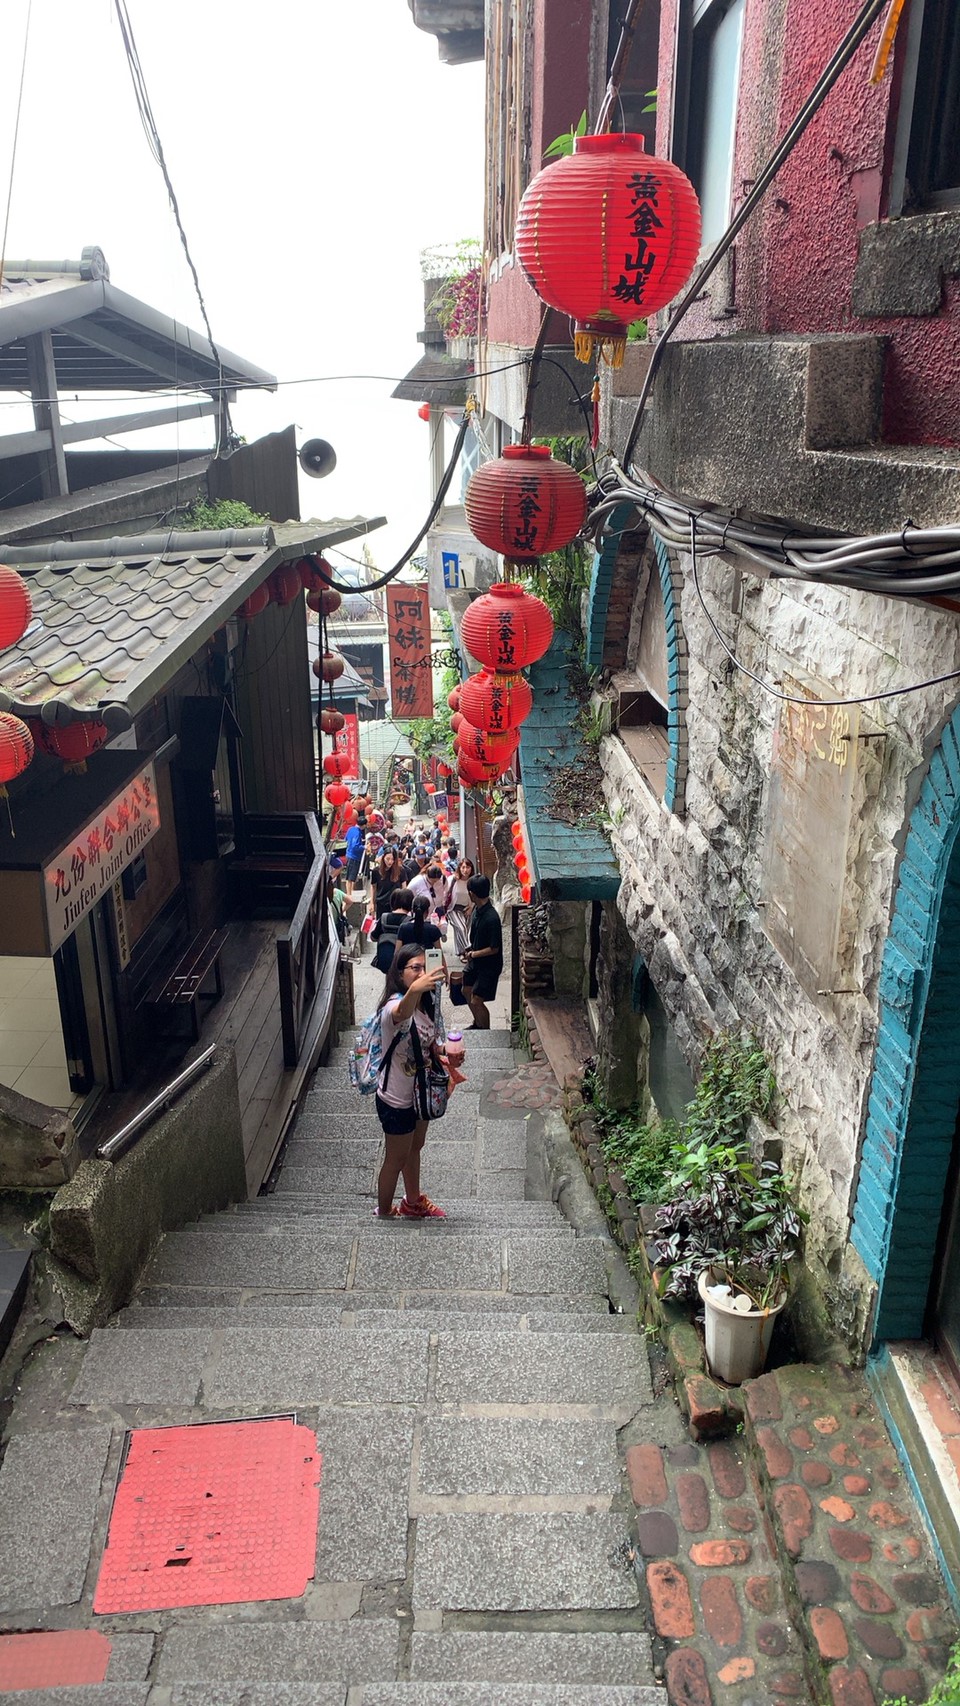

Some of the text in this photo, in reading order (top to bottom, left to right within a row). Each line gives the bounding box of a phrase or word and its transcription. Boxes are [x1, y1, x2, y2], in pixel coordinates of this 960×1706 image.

[63, 882, 97, 931] Jiufen
[100, 846, 124, 888] Joint
[125, 819, 152, 857] Office
